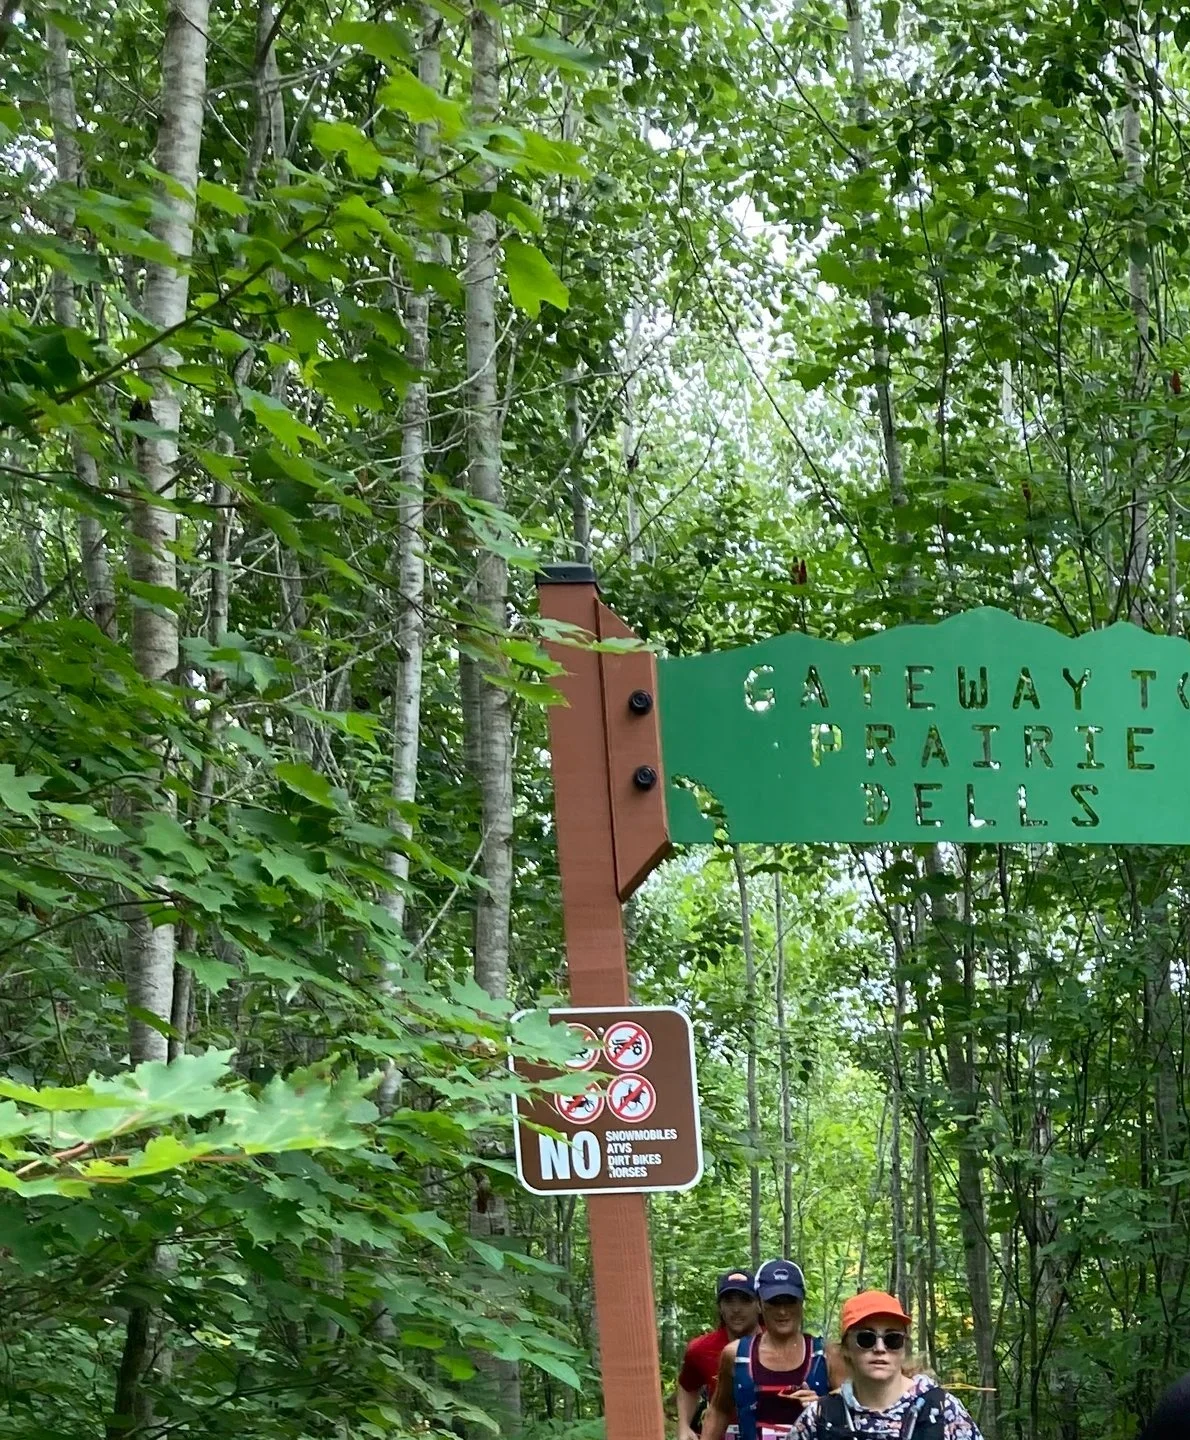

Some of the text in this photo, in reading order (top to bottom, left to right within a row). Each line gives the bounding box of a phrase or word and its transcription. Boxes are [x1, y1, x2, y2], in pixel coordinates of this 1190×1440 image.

[743, 664, 1092, 712] GATEWAY
[810, 723, 1156, 770] PRAIRIE
[860, 782, 1100, 828] DELLS
[539, 1131, 600, 1180] NO
[605, 1129, 678, 1142] SNOWMOBILES
[606, 1142, 633, 1154] ATVS
[607, 1153, 662, 1166] DIRT BIKES
